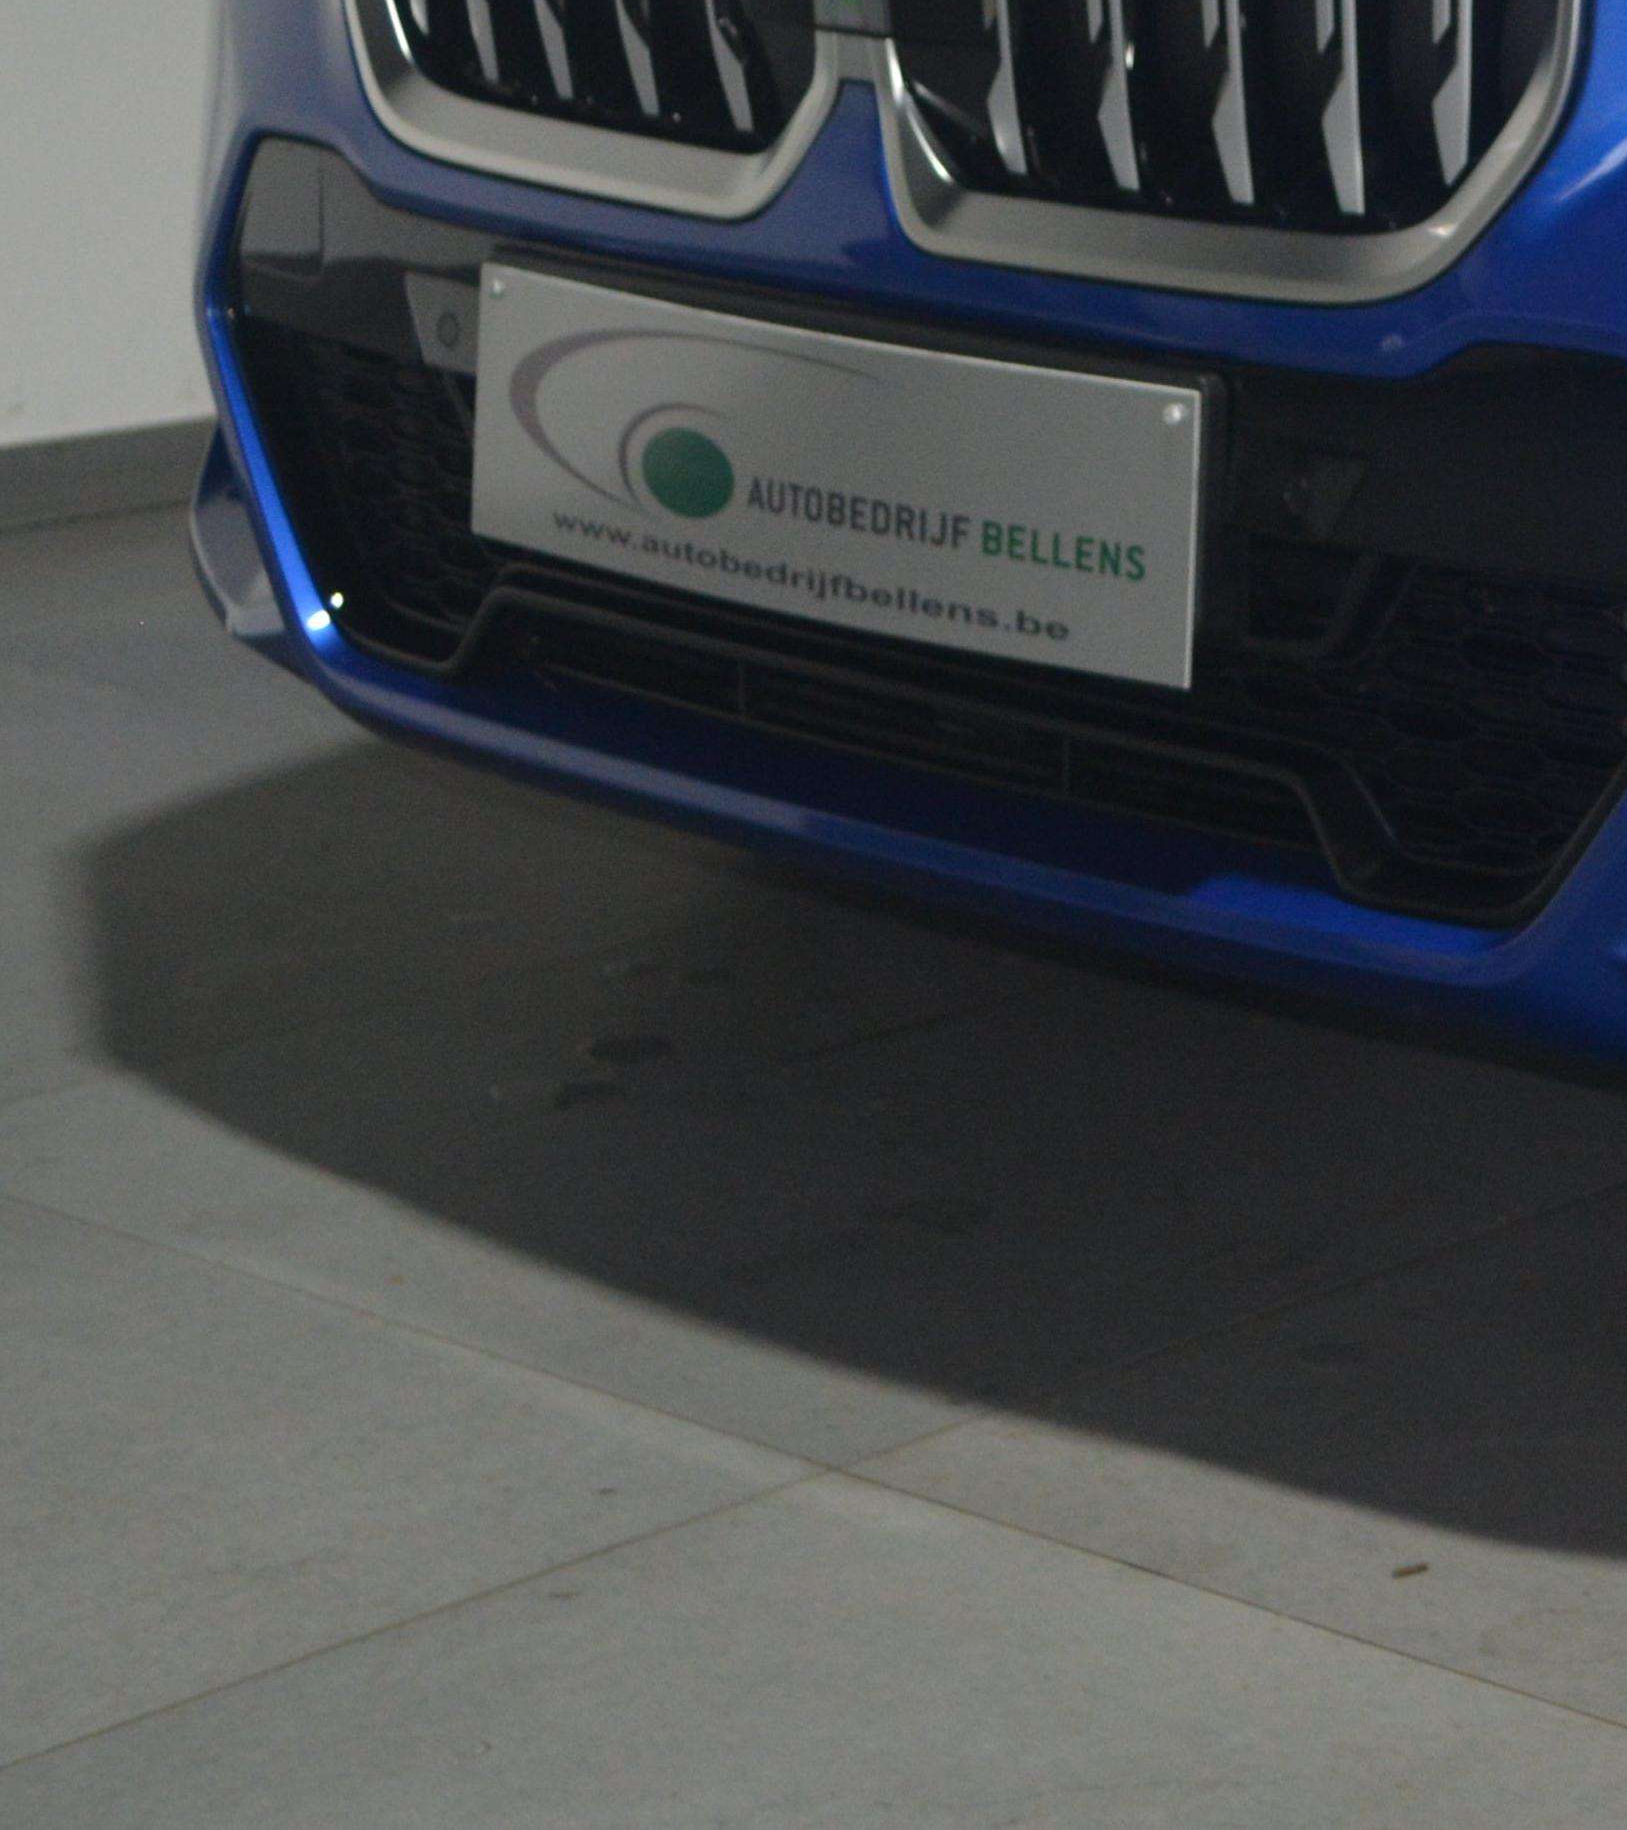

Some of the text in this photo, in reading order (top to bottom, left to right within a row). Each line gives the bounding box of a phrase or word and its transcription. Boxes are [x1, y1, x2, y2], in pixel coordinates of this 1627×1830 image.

[552, 511, 1071, 642] www.autobedrijfbellens.be
[748, 476, 1148, 582] AUTOBEDRIJF BELLENS
